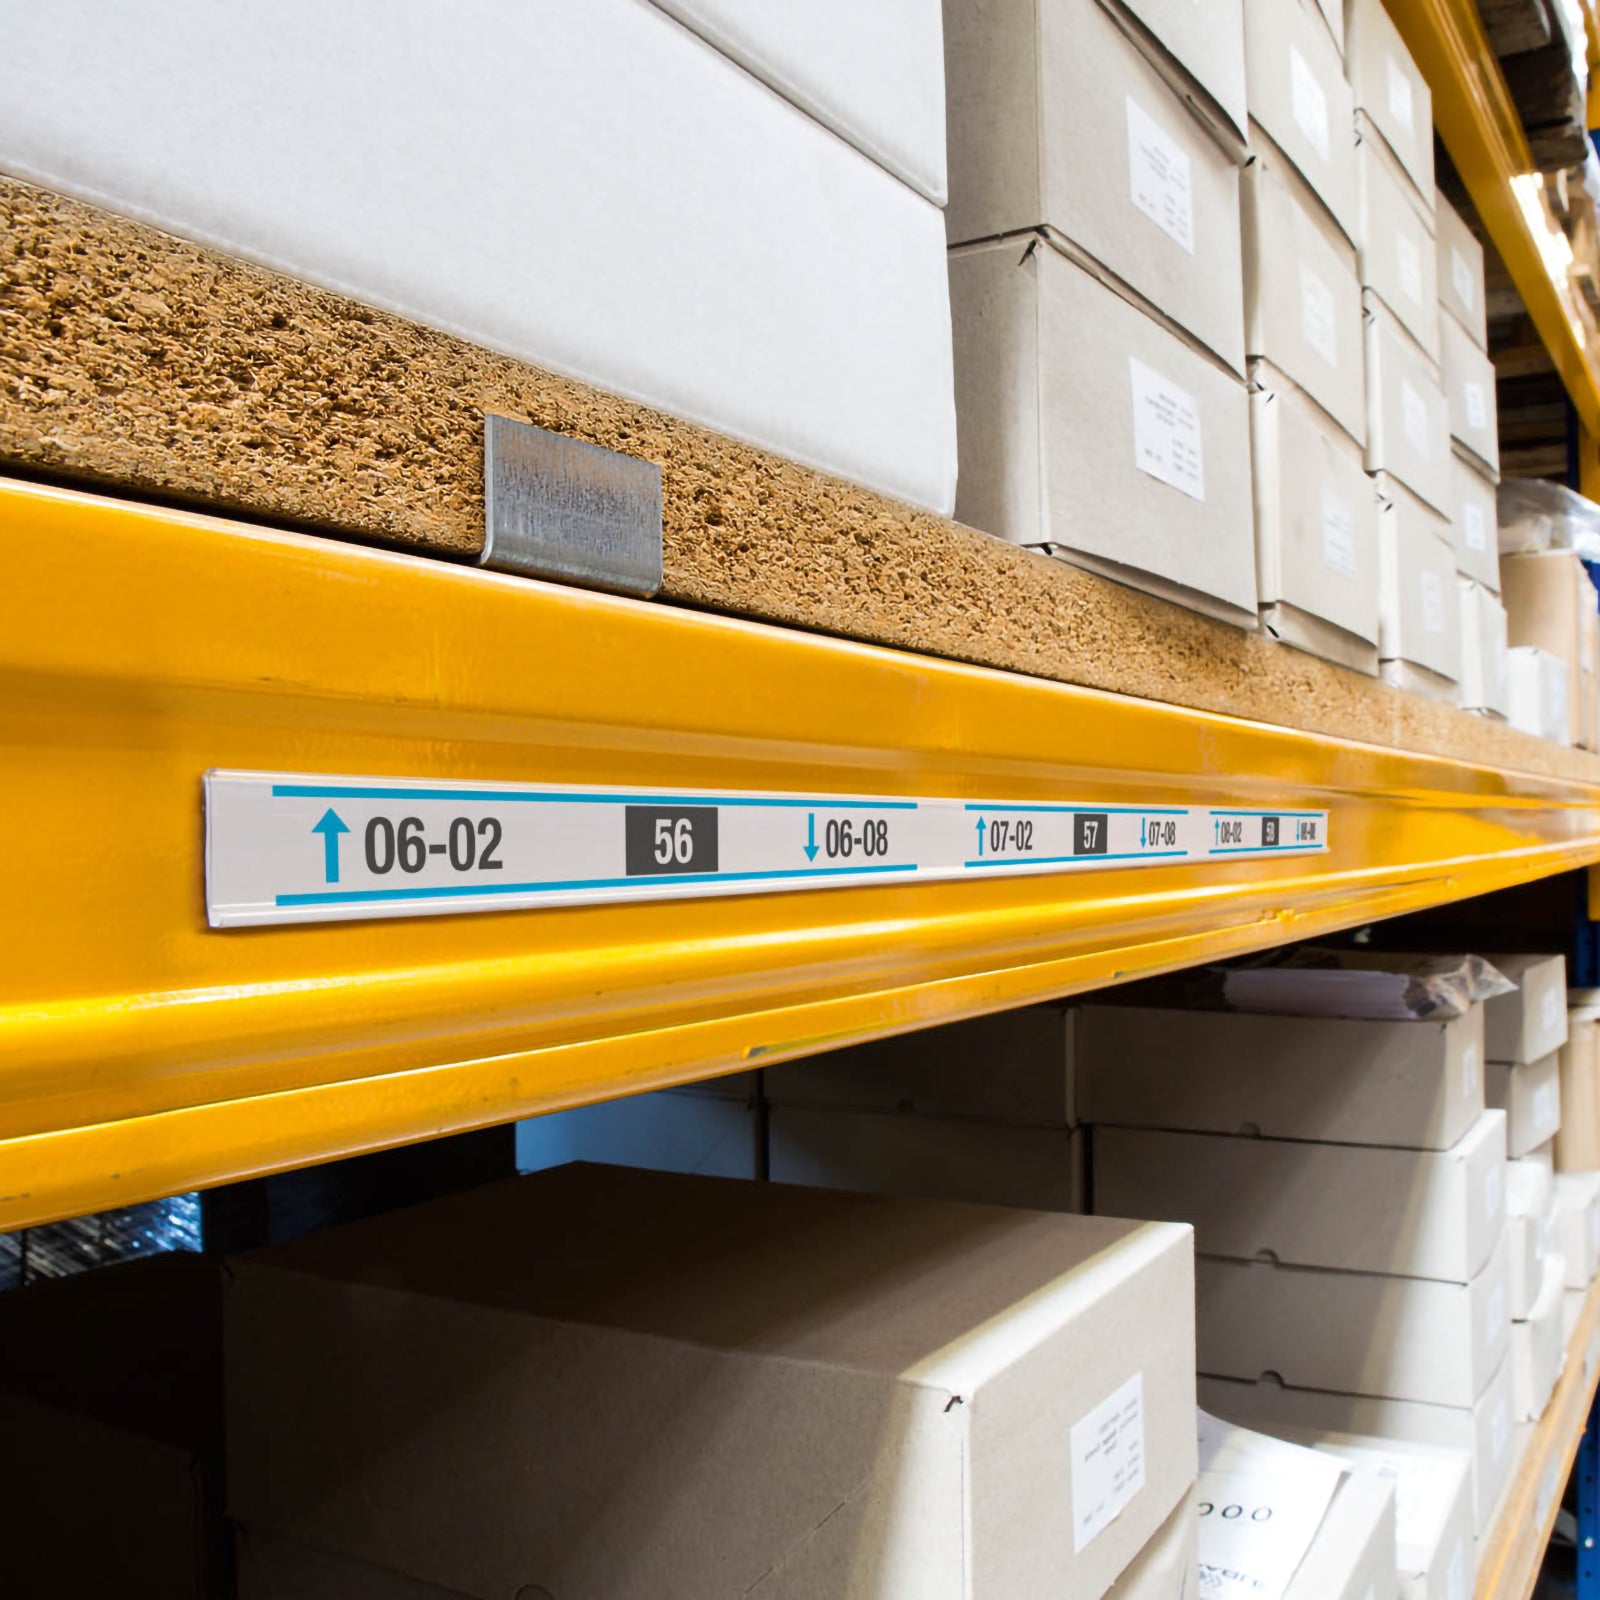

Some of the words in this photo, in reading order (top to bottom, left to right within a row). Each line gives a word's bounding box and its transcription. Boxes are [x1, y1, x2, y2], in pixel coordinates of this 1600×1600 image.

[364, 816, 503, 875] 06-02
[653, 817, 694, 865] 56
[825, 819, 889, 858] 06-08
[990, 820, 1033, 852] 07-02
[1083, 820, 1099, 849] 57
[1148, 821, 1176, 847] 07-08
